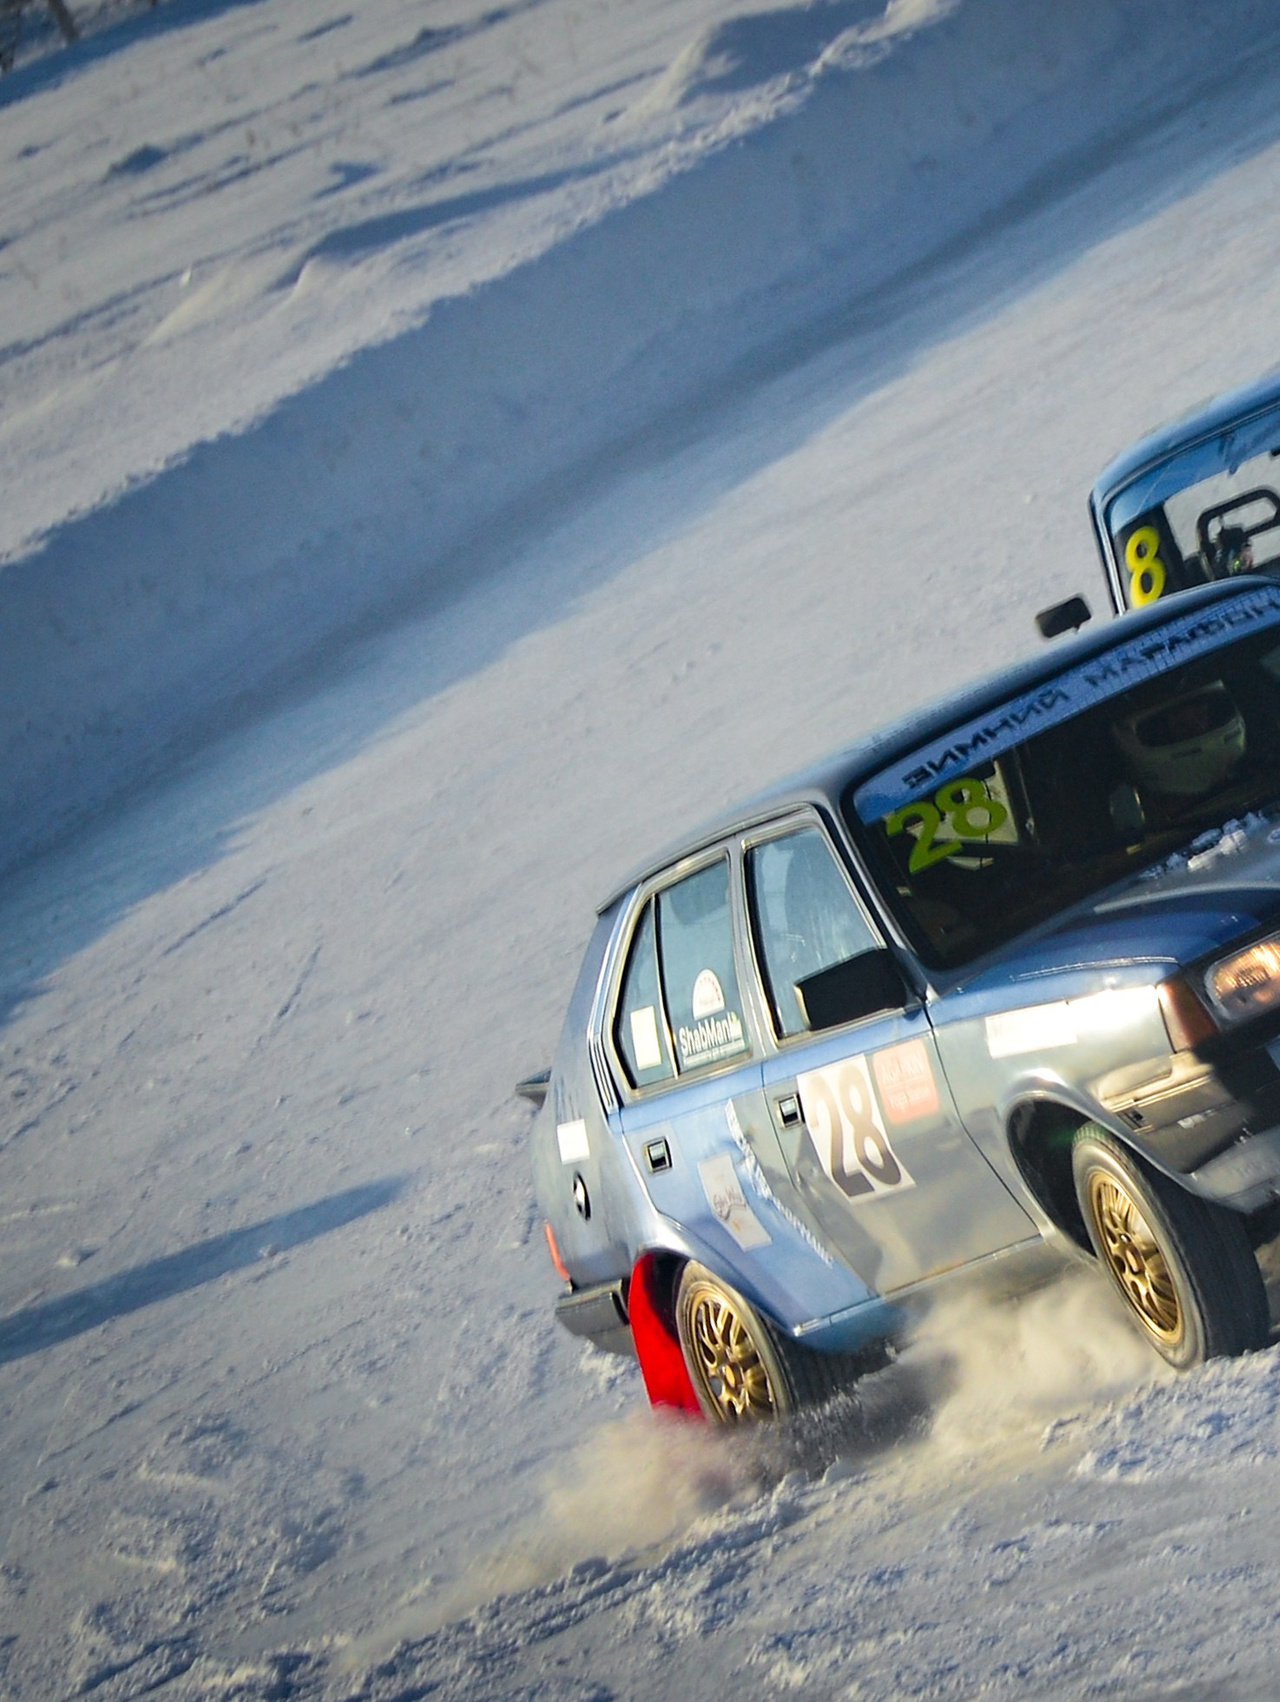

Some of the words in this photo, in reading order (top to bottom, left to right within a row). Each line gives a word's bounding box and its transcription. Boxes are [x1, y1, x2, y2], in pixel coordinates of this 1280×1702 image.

[1124, 526, 1166, 610] 8
[902, 689, 1071, 789] ЗИМНИЙ
[886, 778, 1008, 875] 28
[806, 1063, 902, 1198] 28
